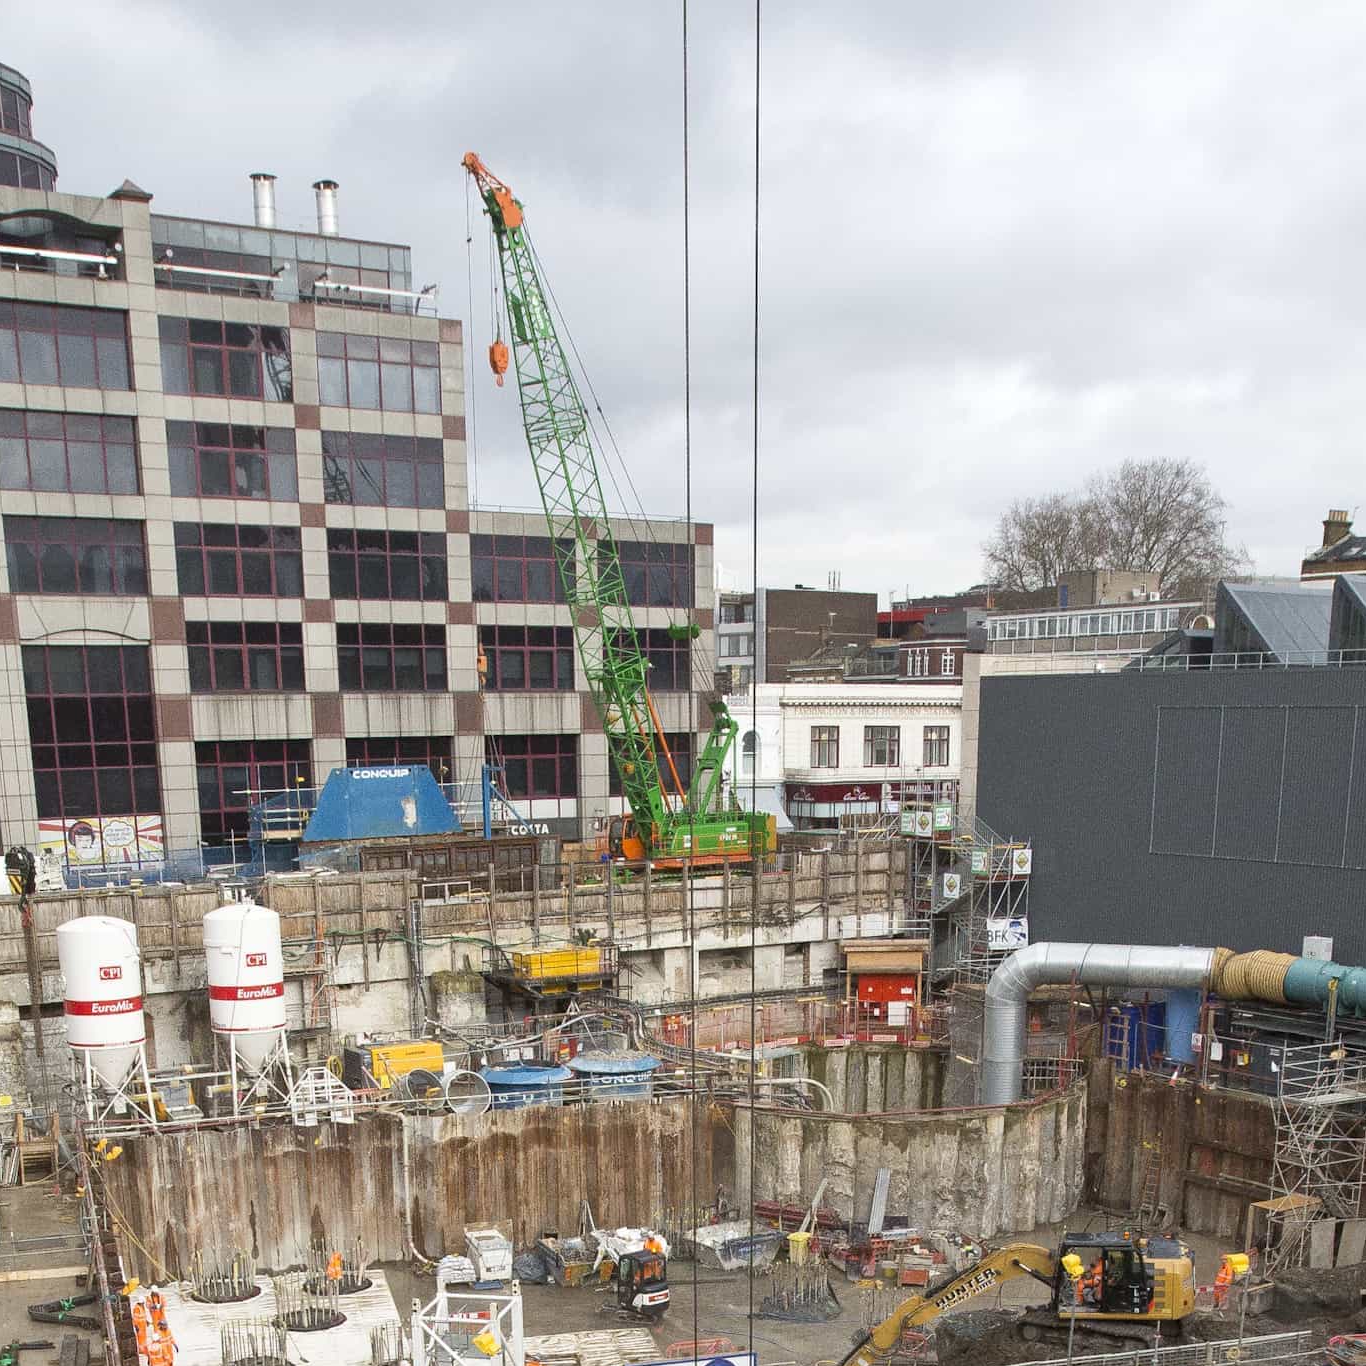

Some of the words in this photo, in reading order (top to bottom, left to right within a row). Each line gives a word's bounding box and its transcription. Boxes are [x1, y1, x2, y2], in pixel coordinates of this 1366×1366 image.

[352, 768, 409, 780] CONQUIP
[246, 954, 267, 966] CPI
[99, 967, 121, 979] CPI
[237, 986, 277, 998] EuroMix
[91, 1000, 133, 1013] EuroMix
[935, 1268, 996, 1308] HUNTER
